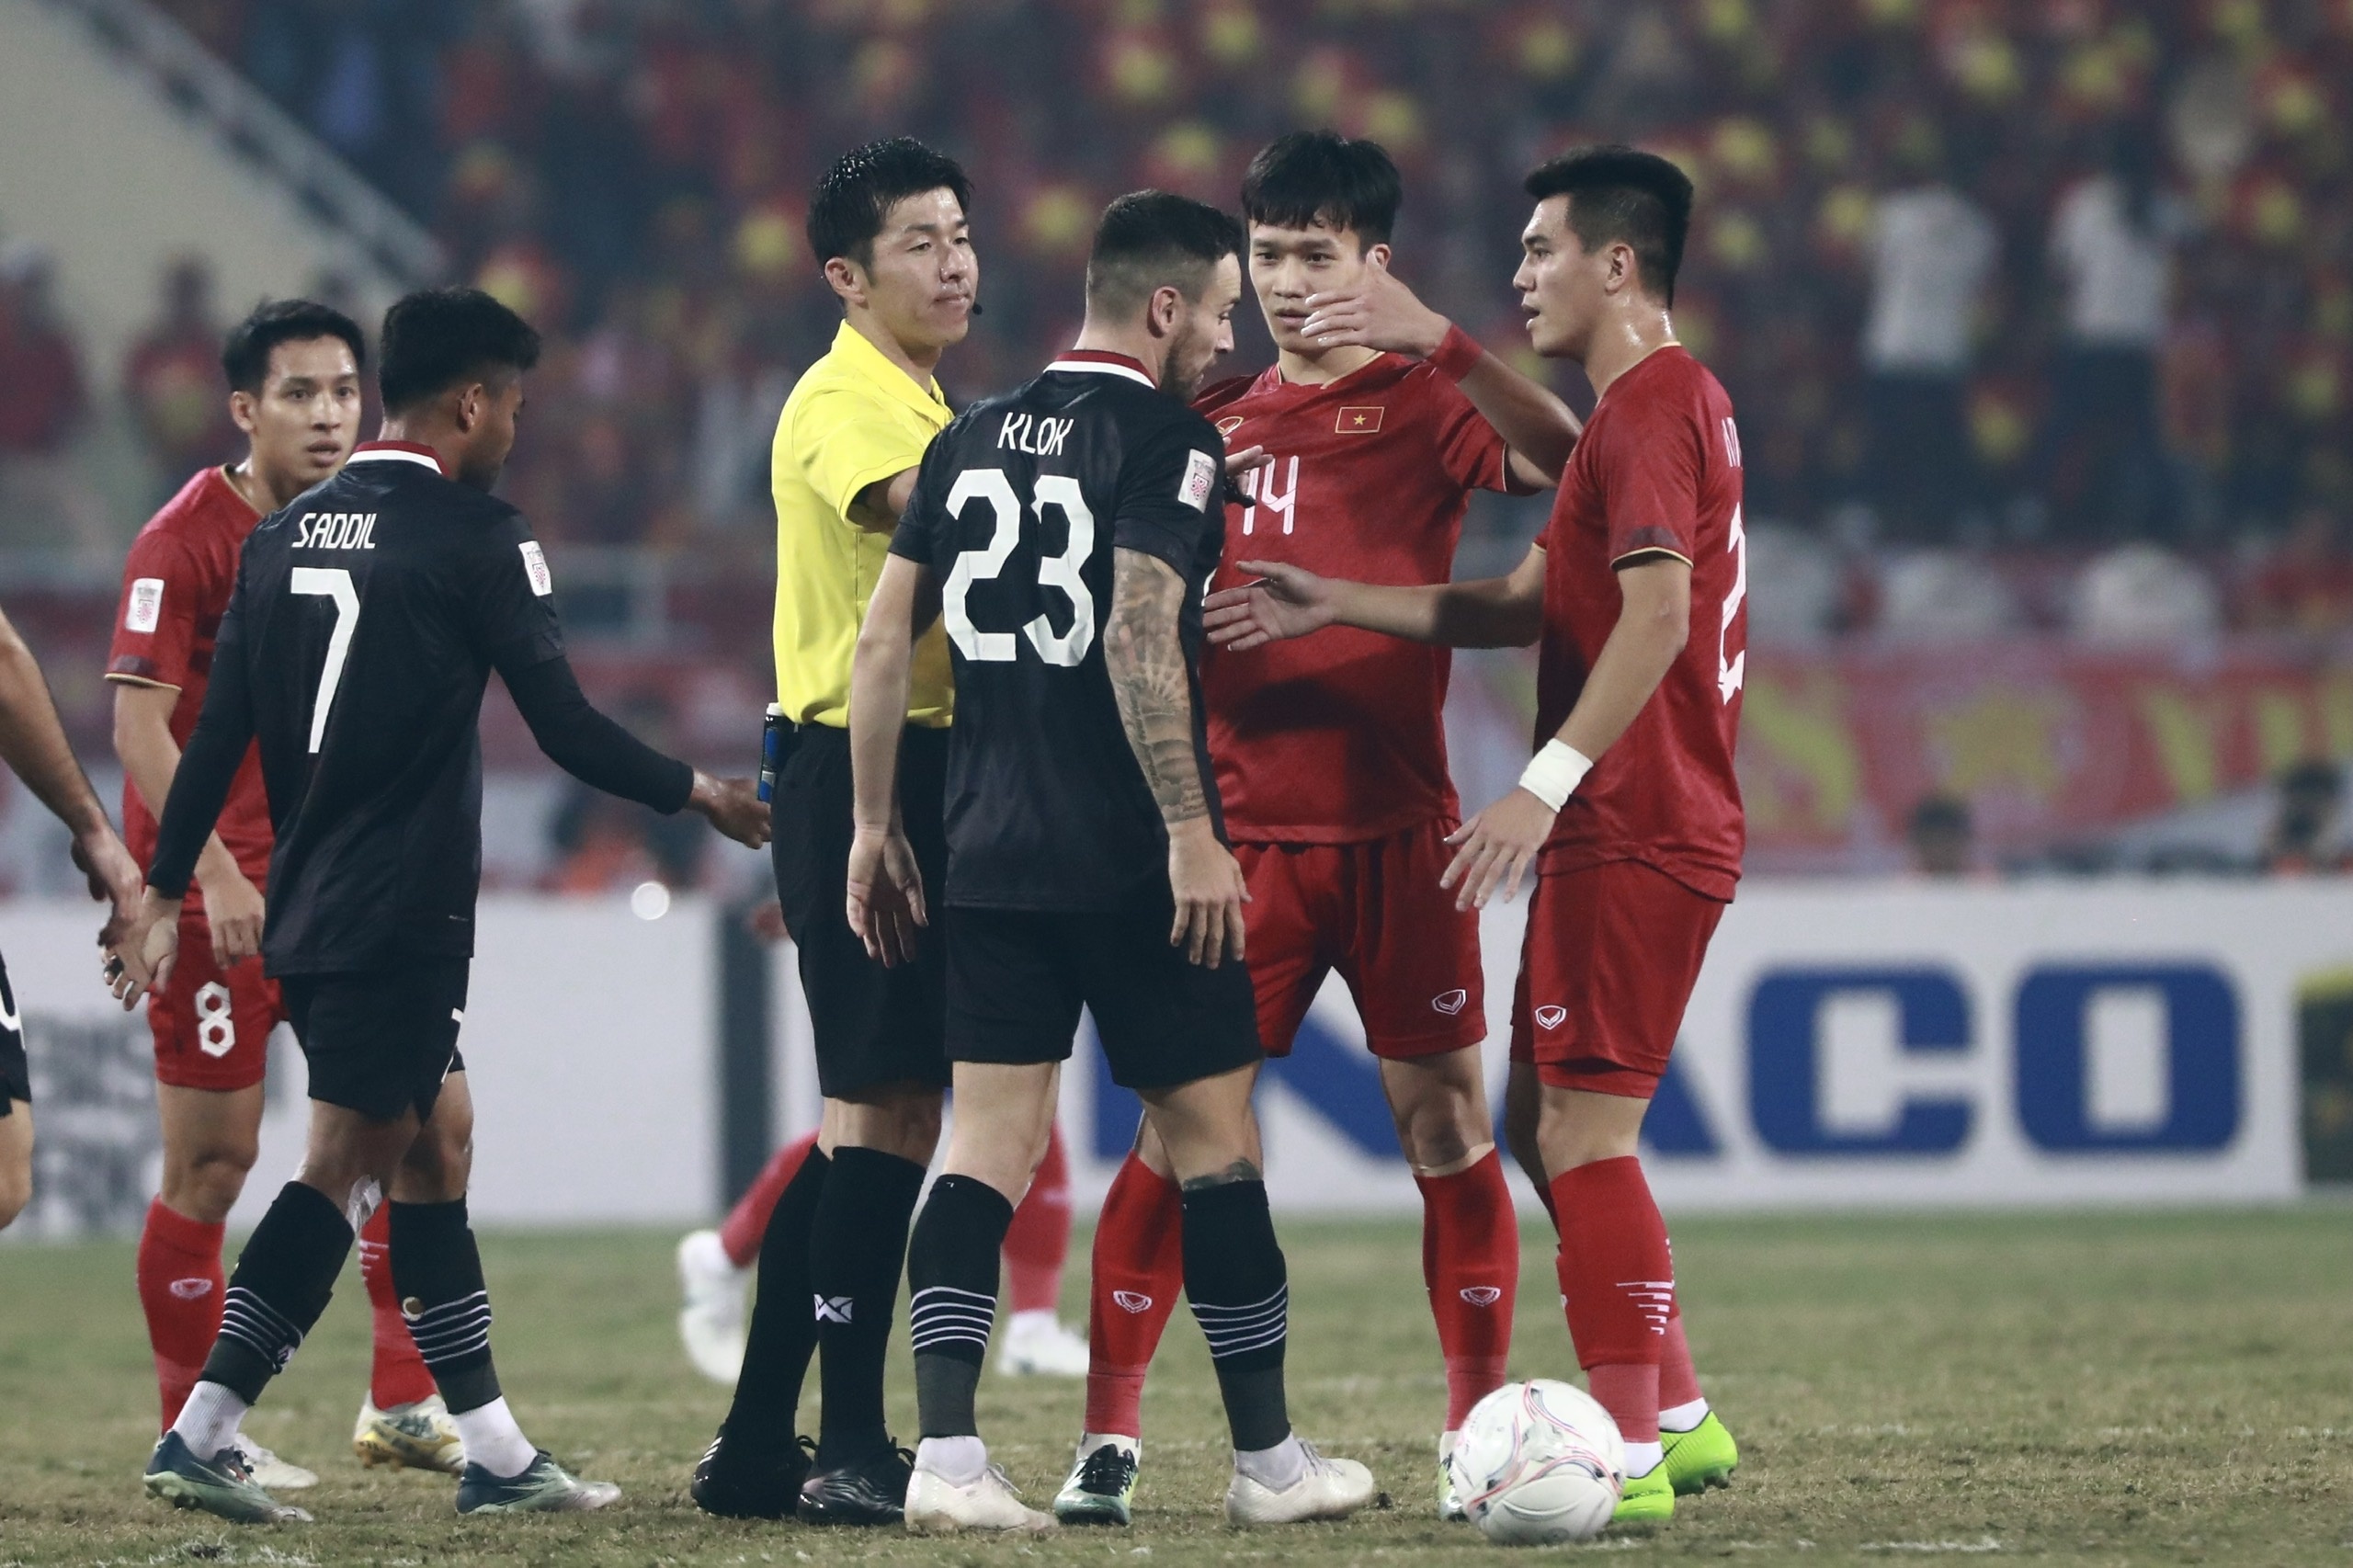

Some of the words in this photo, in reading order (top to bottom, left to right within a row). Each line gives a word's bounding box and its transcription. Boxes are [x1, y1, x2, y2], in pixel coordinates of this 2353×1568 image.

[997, 412, 1074, 456] KLOK
[291, 513, 378, 549] SADDIL
[1243, 455, 1300, 536] 14
[942, 468, 1095, 667] 23
[290, 567, 360, 754] 7
[194, 981, 236, 1058] 8
